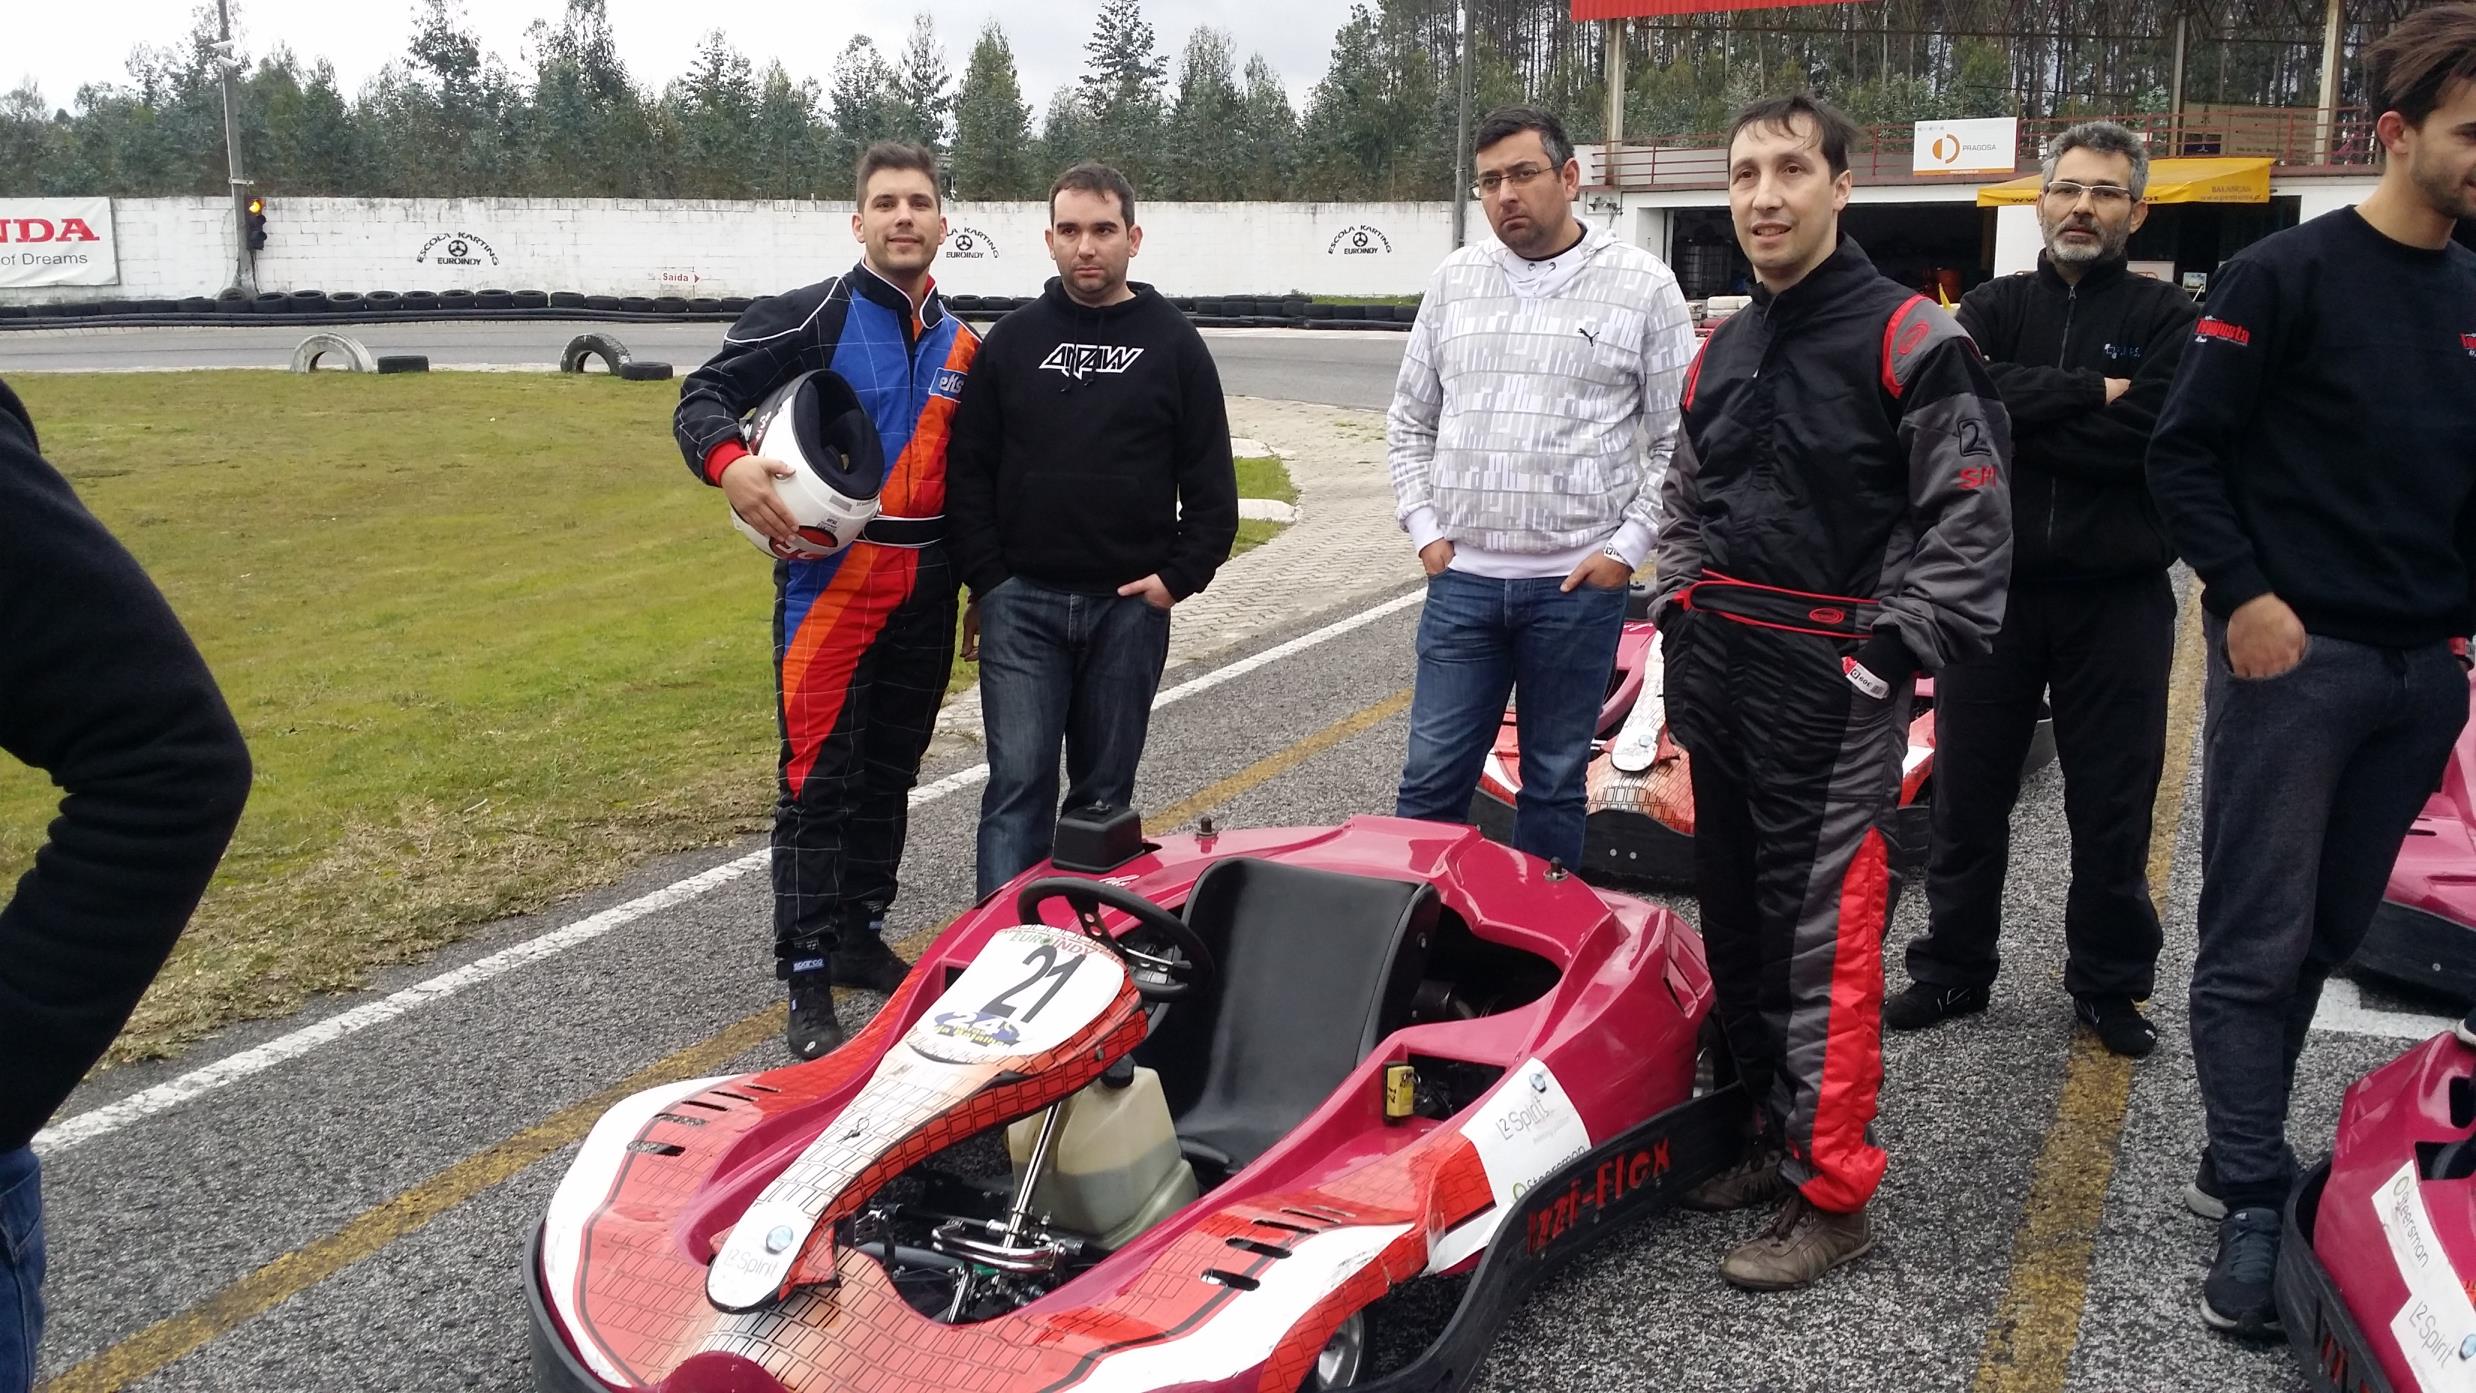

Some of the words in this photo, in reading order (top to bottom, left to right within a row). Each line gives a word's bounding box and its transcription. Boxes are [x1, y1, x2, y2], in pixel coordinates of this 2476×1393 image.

[1962, 144, 1997, 152] PRAGOSA
[458, 231, 499, 266] KARTING
[964, 226, 1000, 259] KARTING
[1328, 225, 1355, 255] ESCOLA
[1360, 224, 1392, 254] KARTING
[1, 253, 16, 266] of
[22, 252, 88, 265] Dreams
[437, 257, 481, 266] EUROINDY
[946, 251, 984, 259] EUROINDY
[1343, 247, 1379, 255] EUROINDY
[978, 944, 1088, 1024] 21
[2395, 1191, 2430, 1268] Steersman
